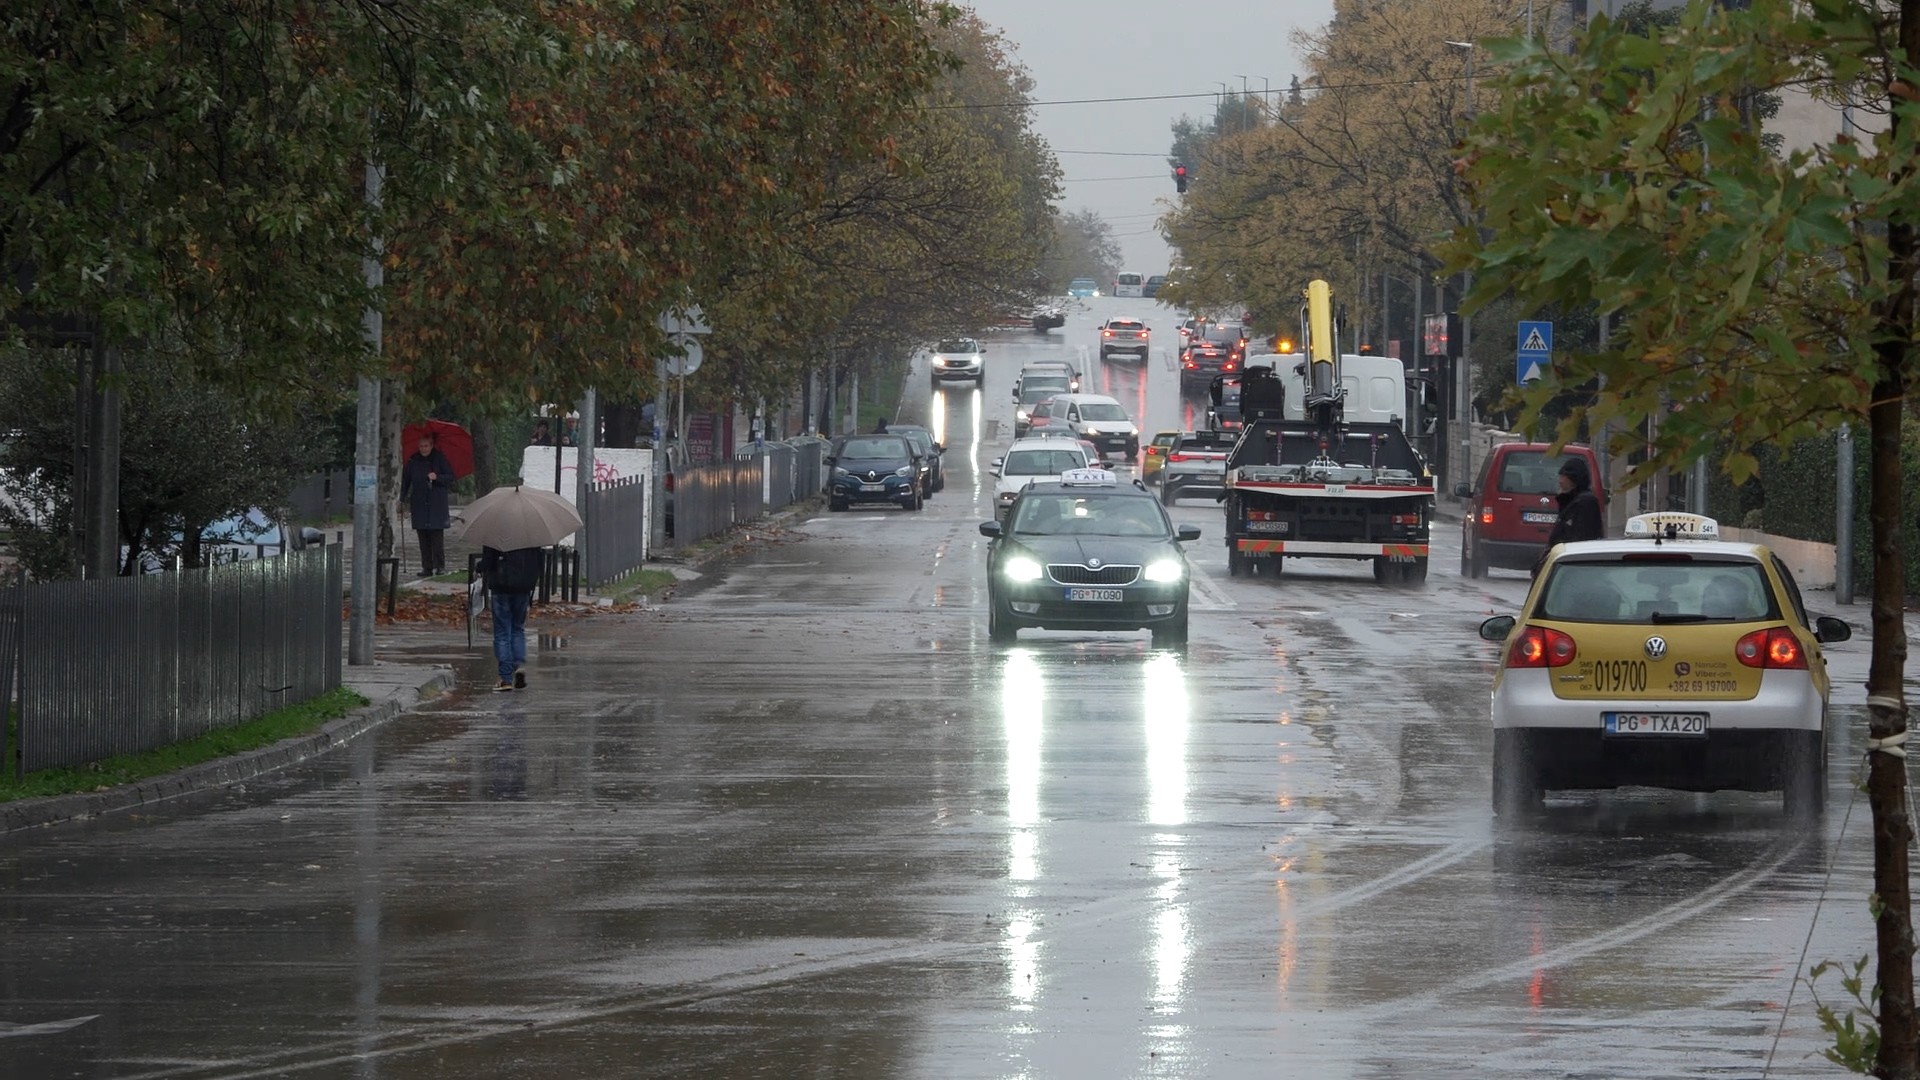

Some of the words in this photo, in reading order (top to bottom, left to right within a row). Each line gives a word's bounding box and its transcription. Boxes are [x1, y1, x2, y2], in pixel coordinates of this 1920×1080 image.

[1072, 590, 1085, 600] PG
[1092, 590, 1122, 600] TX090
[1595, 660, 1647, 692] 019700
[1668, 680, 1689, 692] +382
[1692, 680, 1703, 692] 69
[1706, 680, 1737, 692] 197000
[1617, 715, 1639, 731] PG
[1650, 715, 1703, 732] TXA20
